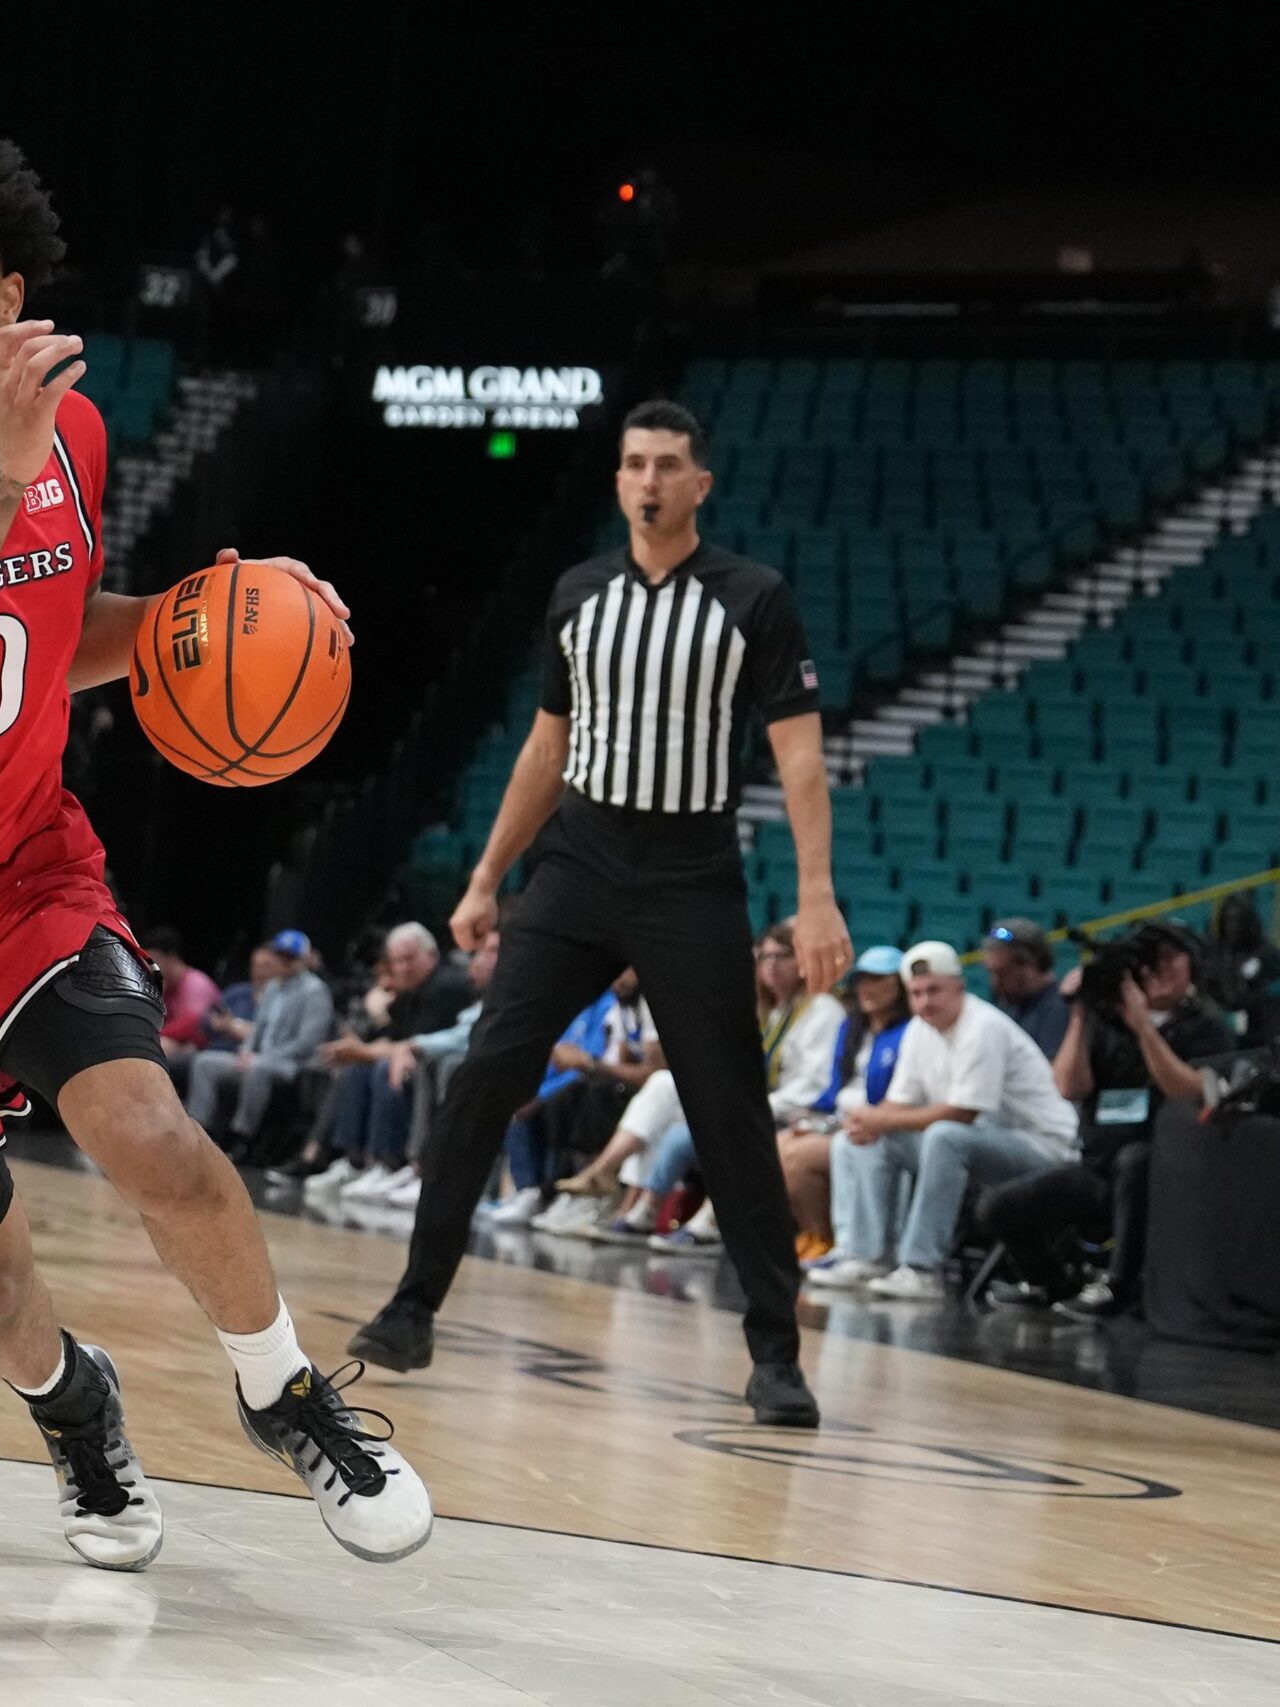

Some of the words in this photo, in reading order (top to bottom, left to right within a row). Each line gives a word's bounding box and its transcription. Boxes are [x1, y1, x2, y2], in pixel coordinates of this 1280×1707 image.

[372, 364, 466, 403] MGM
[468, 364, 604, 405] GRAND
[172, 573, 209, 673] ELITE
[243, 587, 260, 624] NFHS
